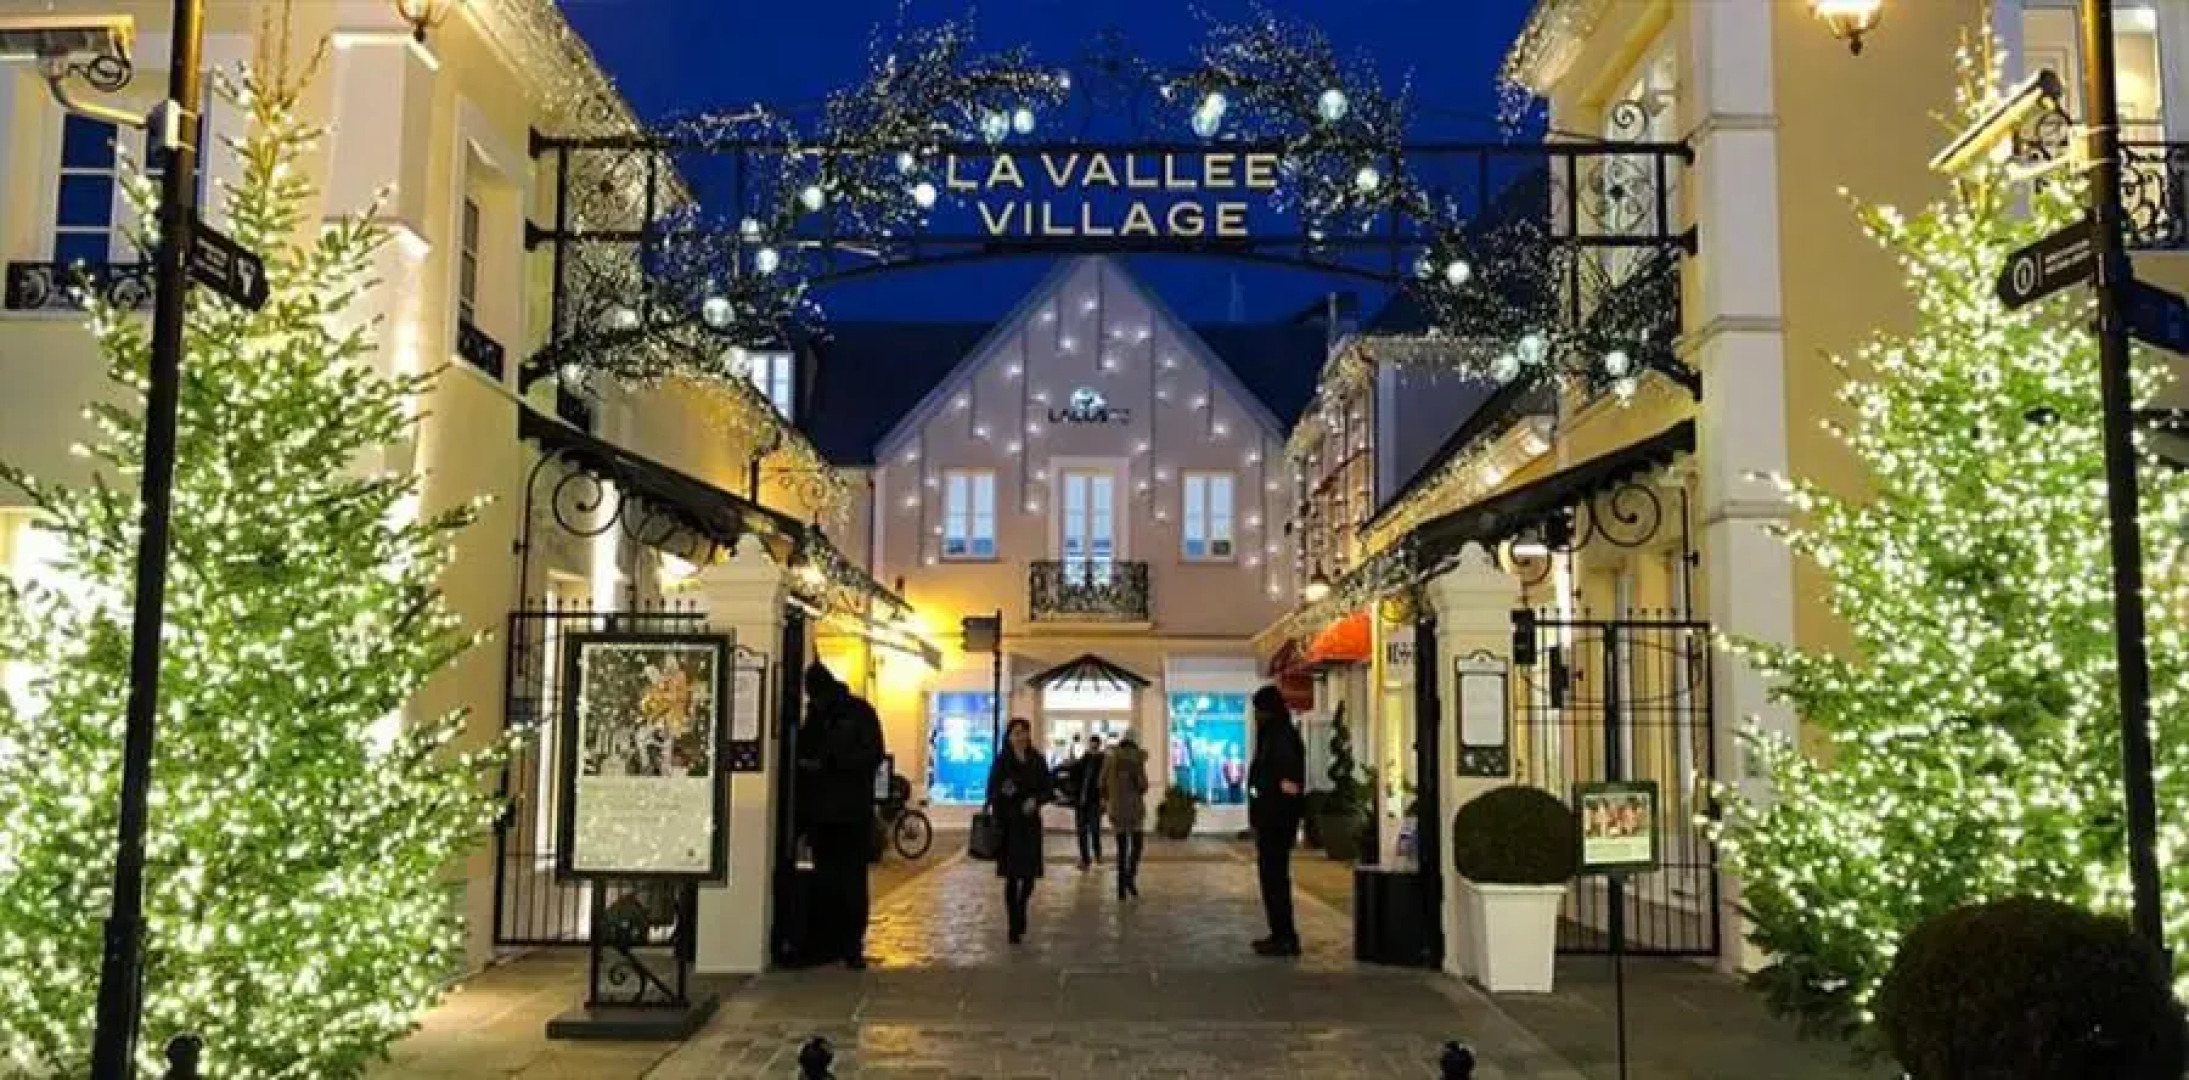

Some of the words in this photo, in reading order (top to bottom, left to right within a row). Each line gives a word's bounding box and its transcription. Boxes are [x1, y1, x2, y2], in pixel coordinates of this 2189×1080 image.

[946, 153, 1024, 188] LA
[1040, 153, 1278, 188] VALLEE
[977, 201, 1248, 235] VILLAGE
